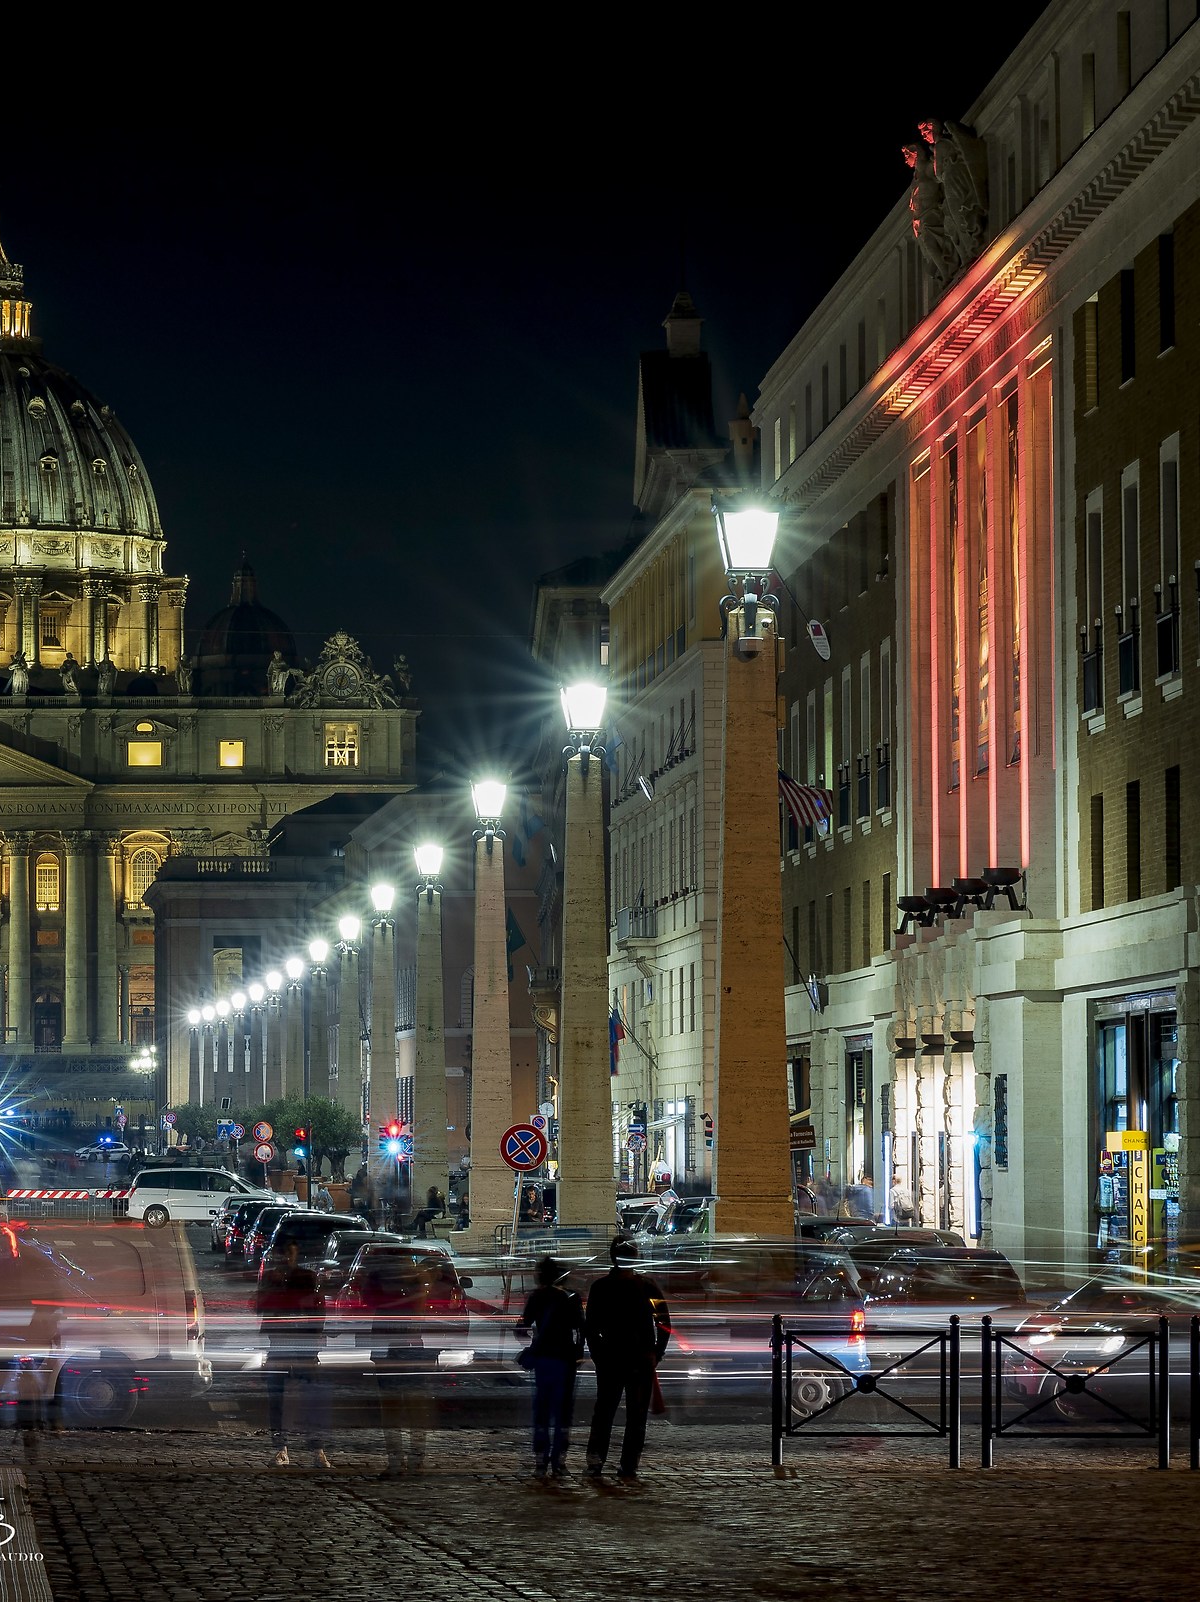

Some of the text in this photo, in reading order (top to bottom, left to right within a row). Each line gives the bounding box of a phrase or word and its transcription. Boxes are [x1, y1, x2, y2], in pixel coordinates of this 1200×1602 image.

[16, 803, 84, 814] ROMANVS
[122, 803, 151, 813] MAX
[152, 803, 171, 813] AN
[173, 803, 227, 813] MDCXII
[269, 802, 288, 813] VII
